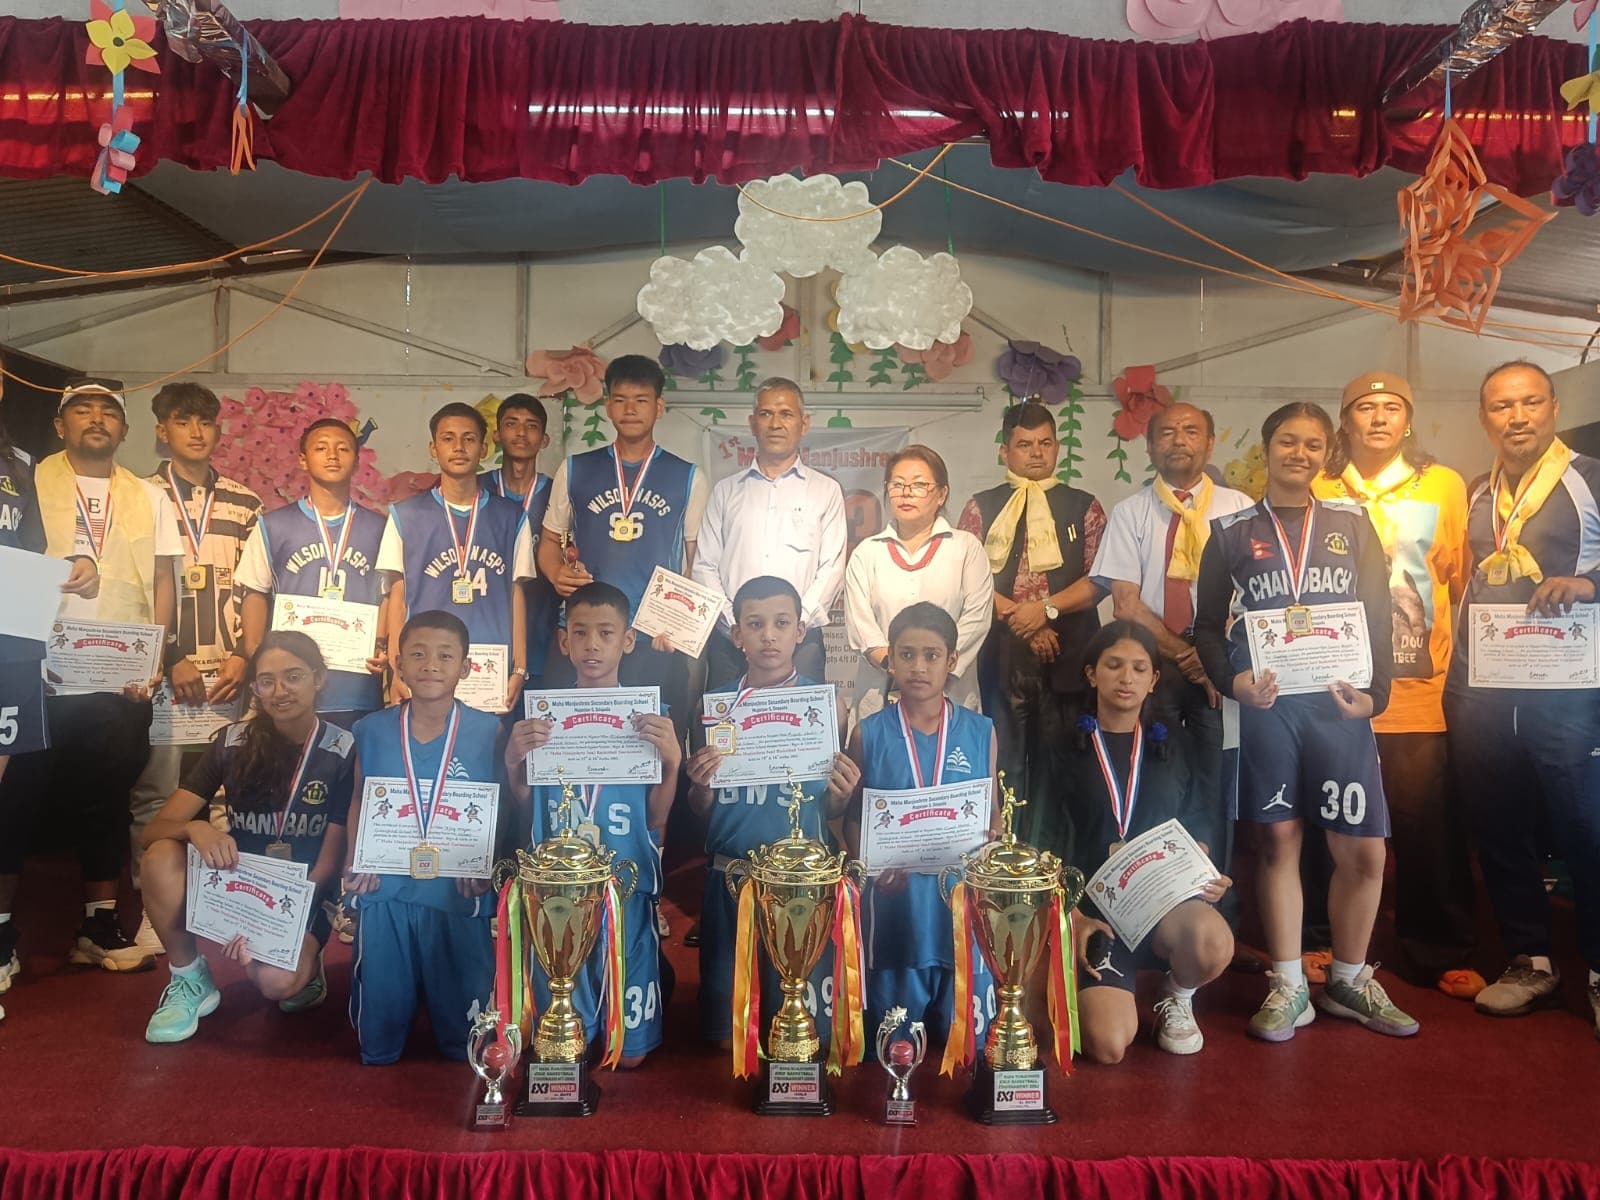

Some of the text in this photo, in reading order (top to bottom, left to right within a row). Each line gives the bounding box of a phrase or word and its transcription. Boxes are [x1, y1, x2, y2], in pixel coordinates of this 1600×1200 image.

[572, 714, 618, 724] Certificate
[750, 713, 794, 724] Certificate
[1320, 780, 1366, 825] 30
[909, 810, 951, 820] Certificate
[234, 881, 271, 902] Certificate
[624, 980, 657, 1029] 34
